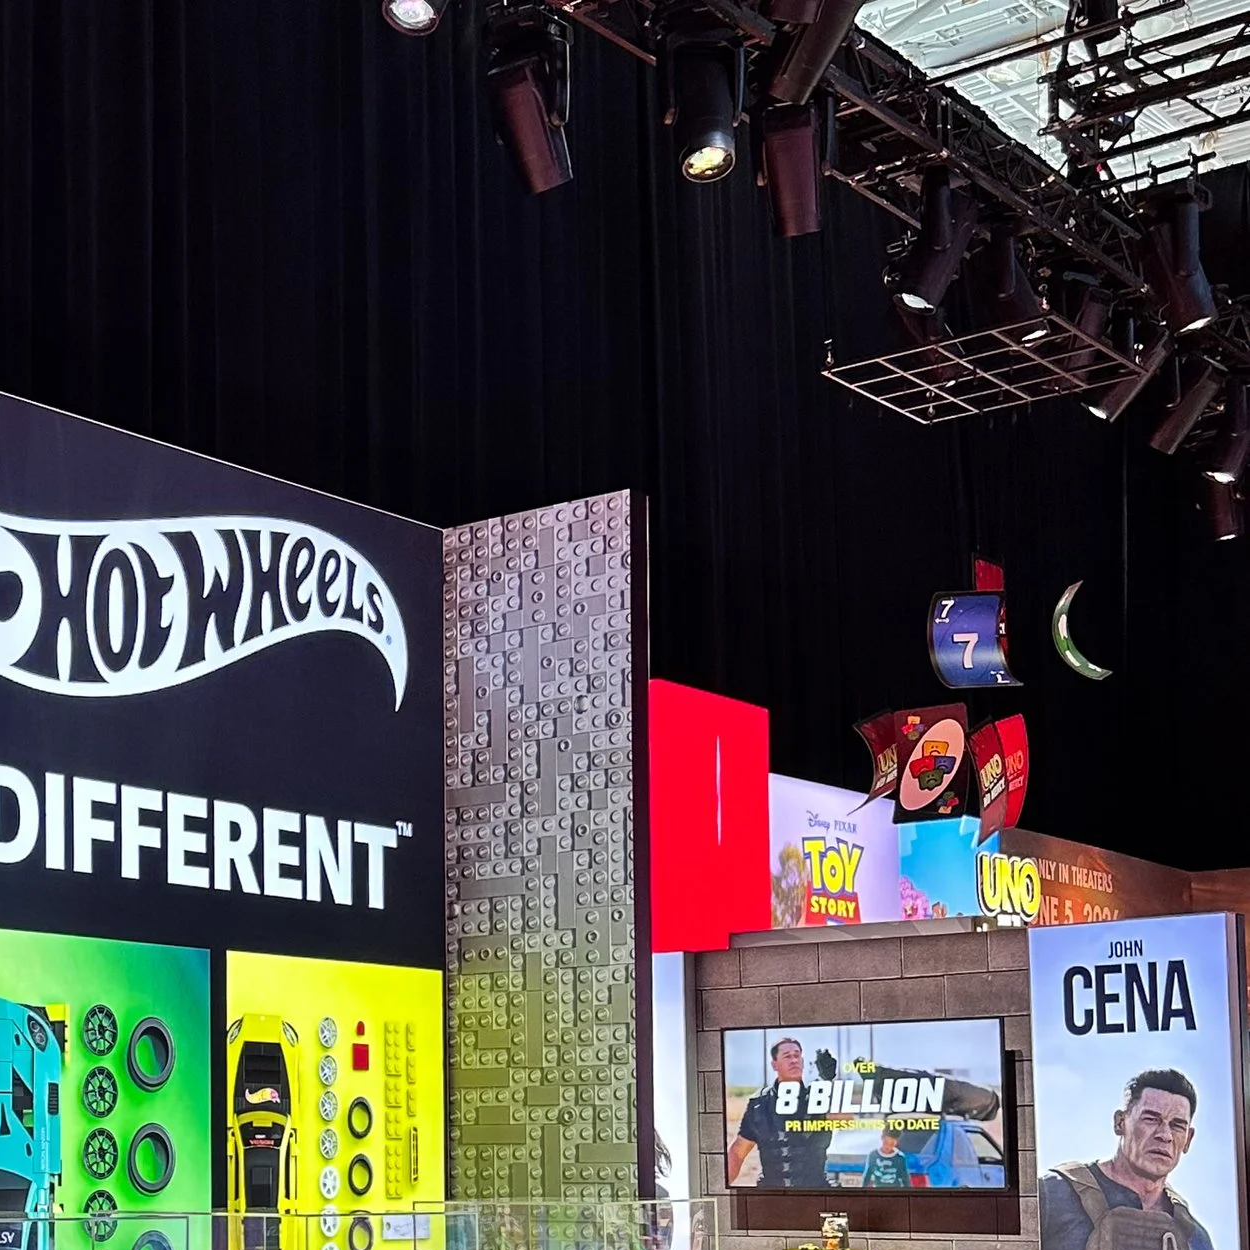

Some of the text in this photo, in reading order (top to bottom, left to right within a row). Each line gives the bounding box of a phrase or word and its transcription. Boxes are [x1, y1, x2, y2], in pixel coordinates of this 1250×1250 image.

[940, 599, 955, 619] 7
[952, 632, 979, 669] 7
[876, 743, 898, 776] UN
[979, 752, 1003, 792] UNO
[806, 810, 857, 834] Disney PIXAR
[801, 836, 865, 897] TOY
[1038, 857, 1113, 893] NLY IN THEATERS
[976, 852, 1042, 923] UNO
[810, 896, 857, 919] STORY
[1038, 894, 1059, 926] NE
[1108, 939, 1144, 959] JOHN
[1063, 959, 1197, 1036] CENA
[843, 1061, 877, 1074] OVER
[775, 1076, 946, 1115] 8 BILLION
[784, 1117, 940, 1132] PR IMPRESSIONS TO DATE
